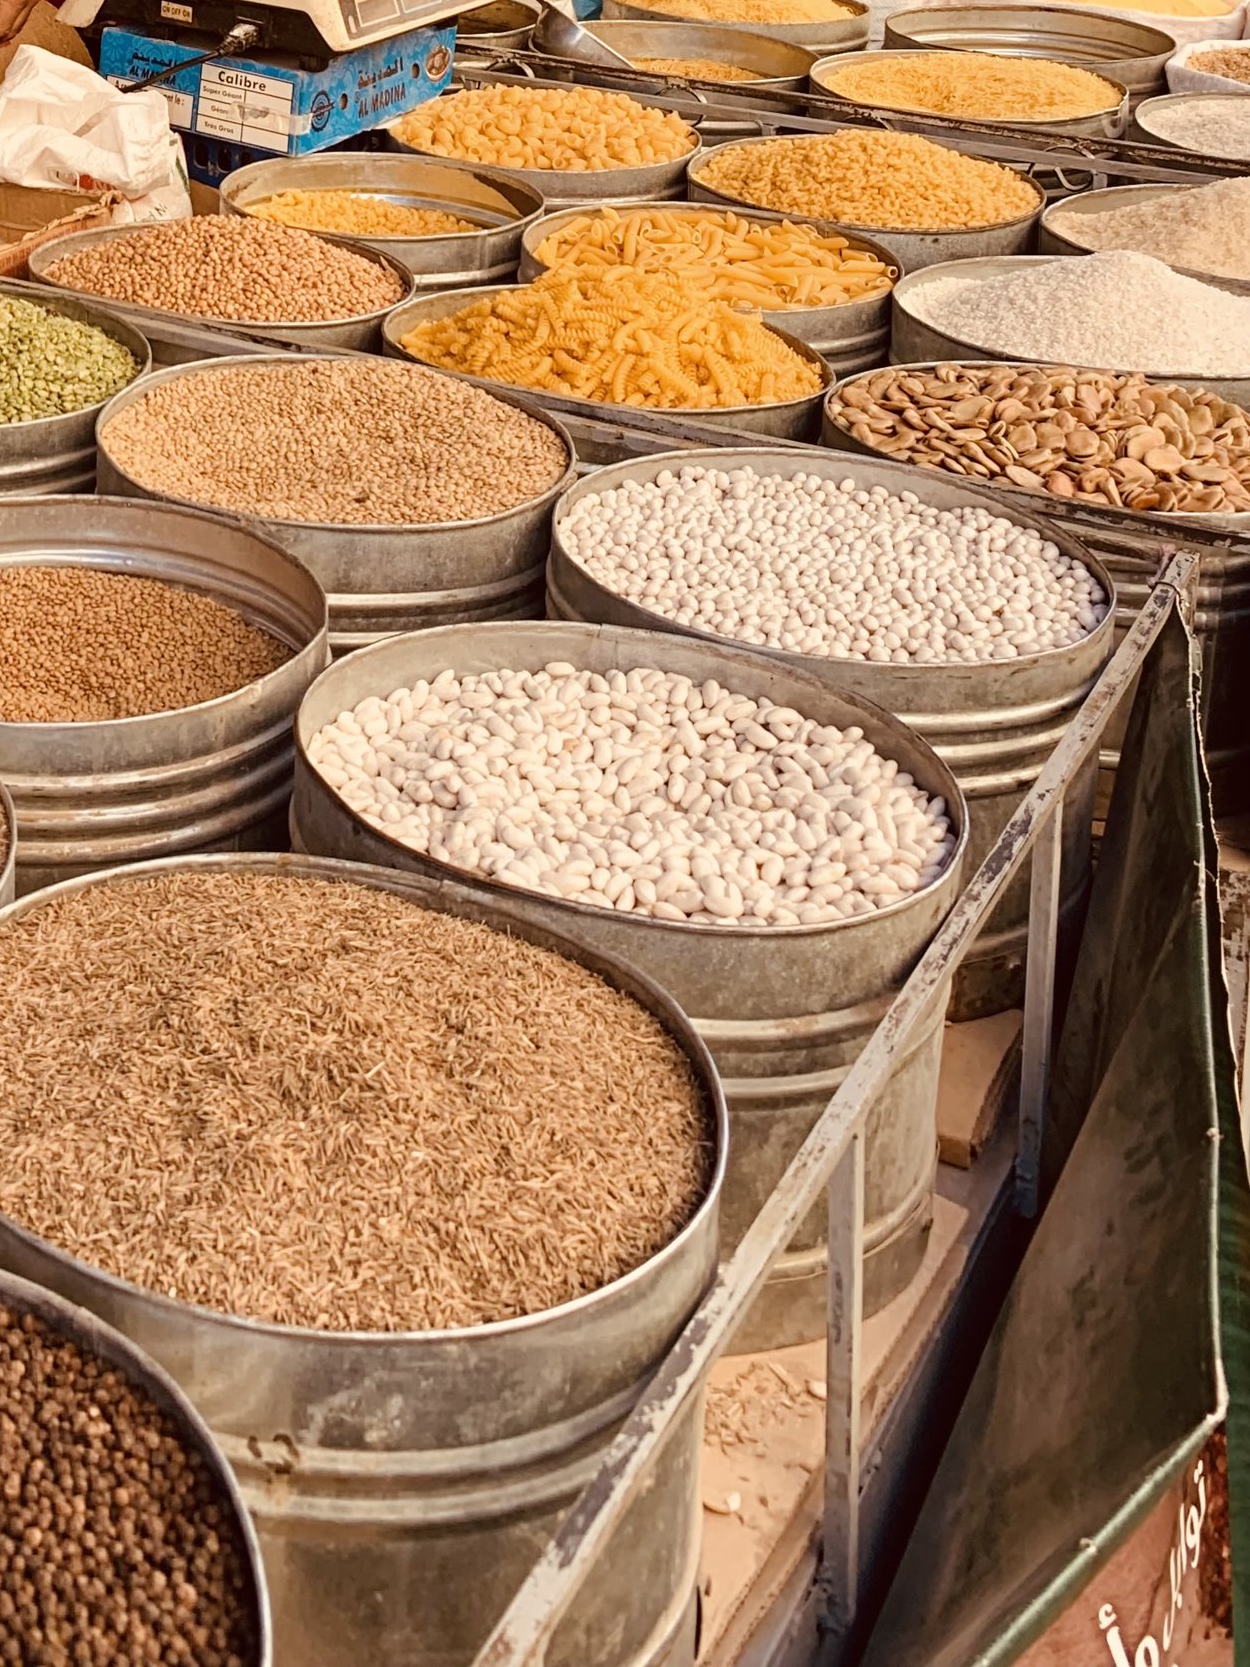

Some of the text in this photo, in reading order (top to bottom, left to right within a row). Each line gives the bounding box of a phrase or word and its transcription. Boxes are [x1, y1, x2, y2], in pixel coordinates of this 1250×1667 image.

[218, 71, 267, 92] Calibre
[203, 85, 242, 100] Super Géant
[359, 83, 406, 119] AL MADINA
[211, 105, 229, 115] Géan
[218, 124, 234, 134] Gros
